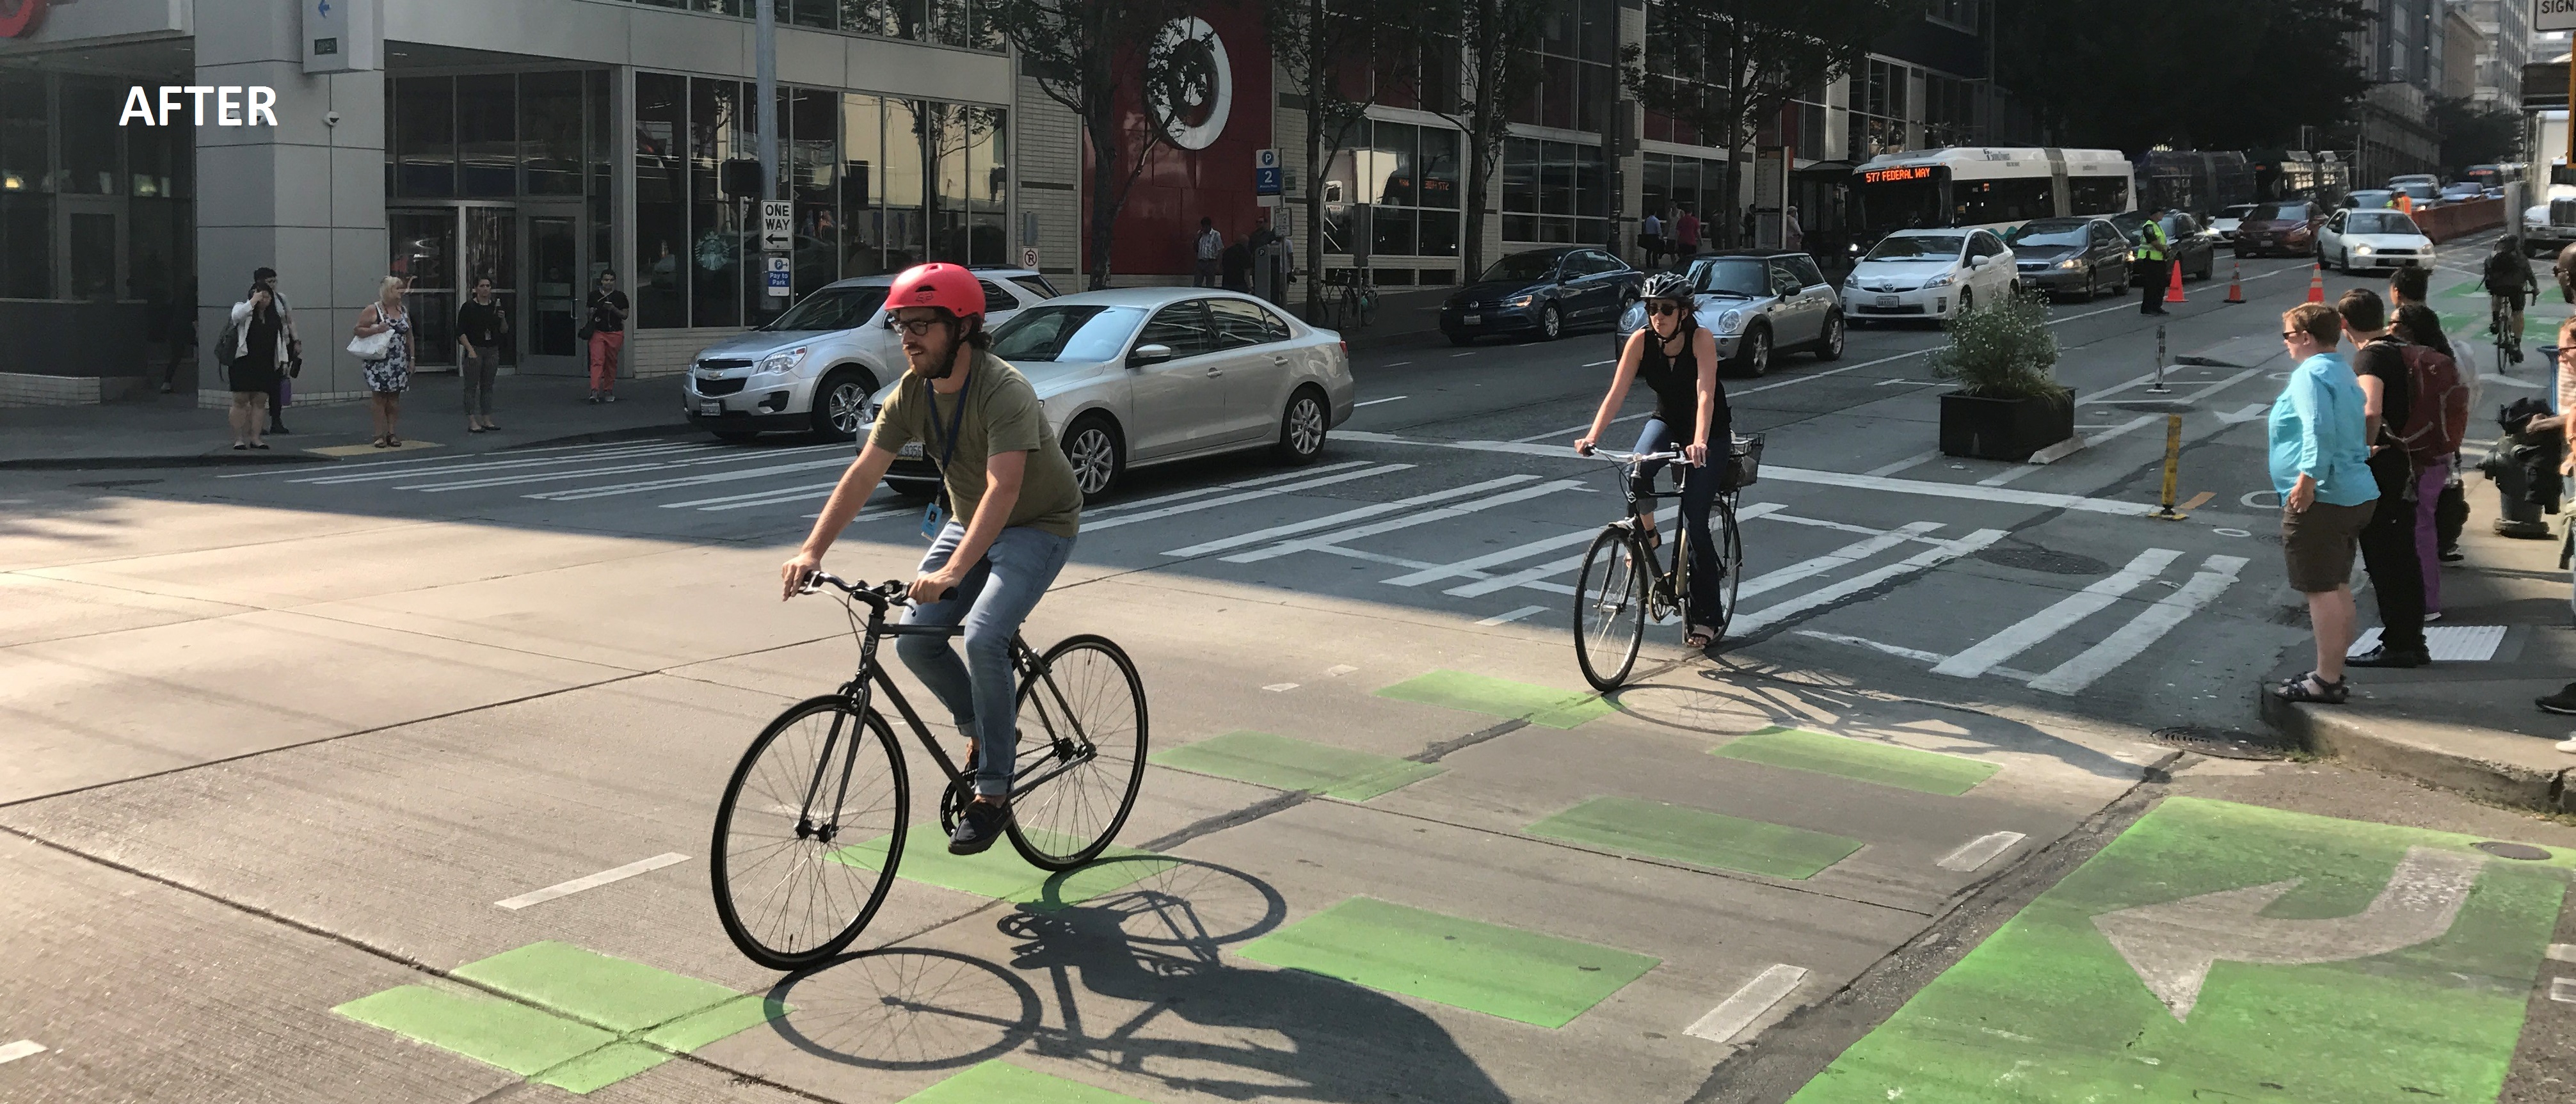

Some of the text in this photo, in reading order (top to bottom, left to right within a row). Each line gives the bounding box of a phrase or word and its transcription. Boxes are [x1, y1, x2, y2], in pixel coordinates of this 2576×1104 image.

[2541, 0, 2576, 13] SIGN
[1265, 153, 1272, 163] P
[1265, 170, 1273, 183] 2
[1866, 167, 1931, 183] 577 FEDERAL WAY
[765, 204, 790, 216] ONE
[765, 218, 790, 230] WAY
